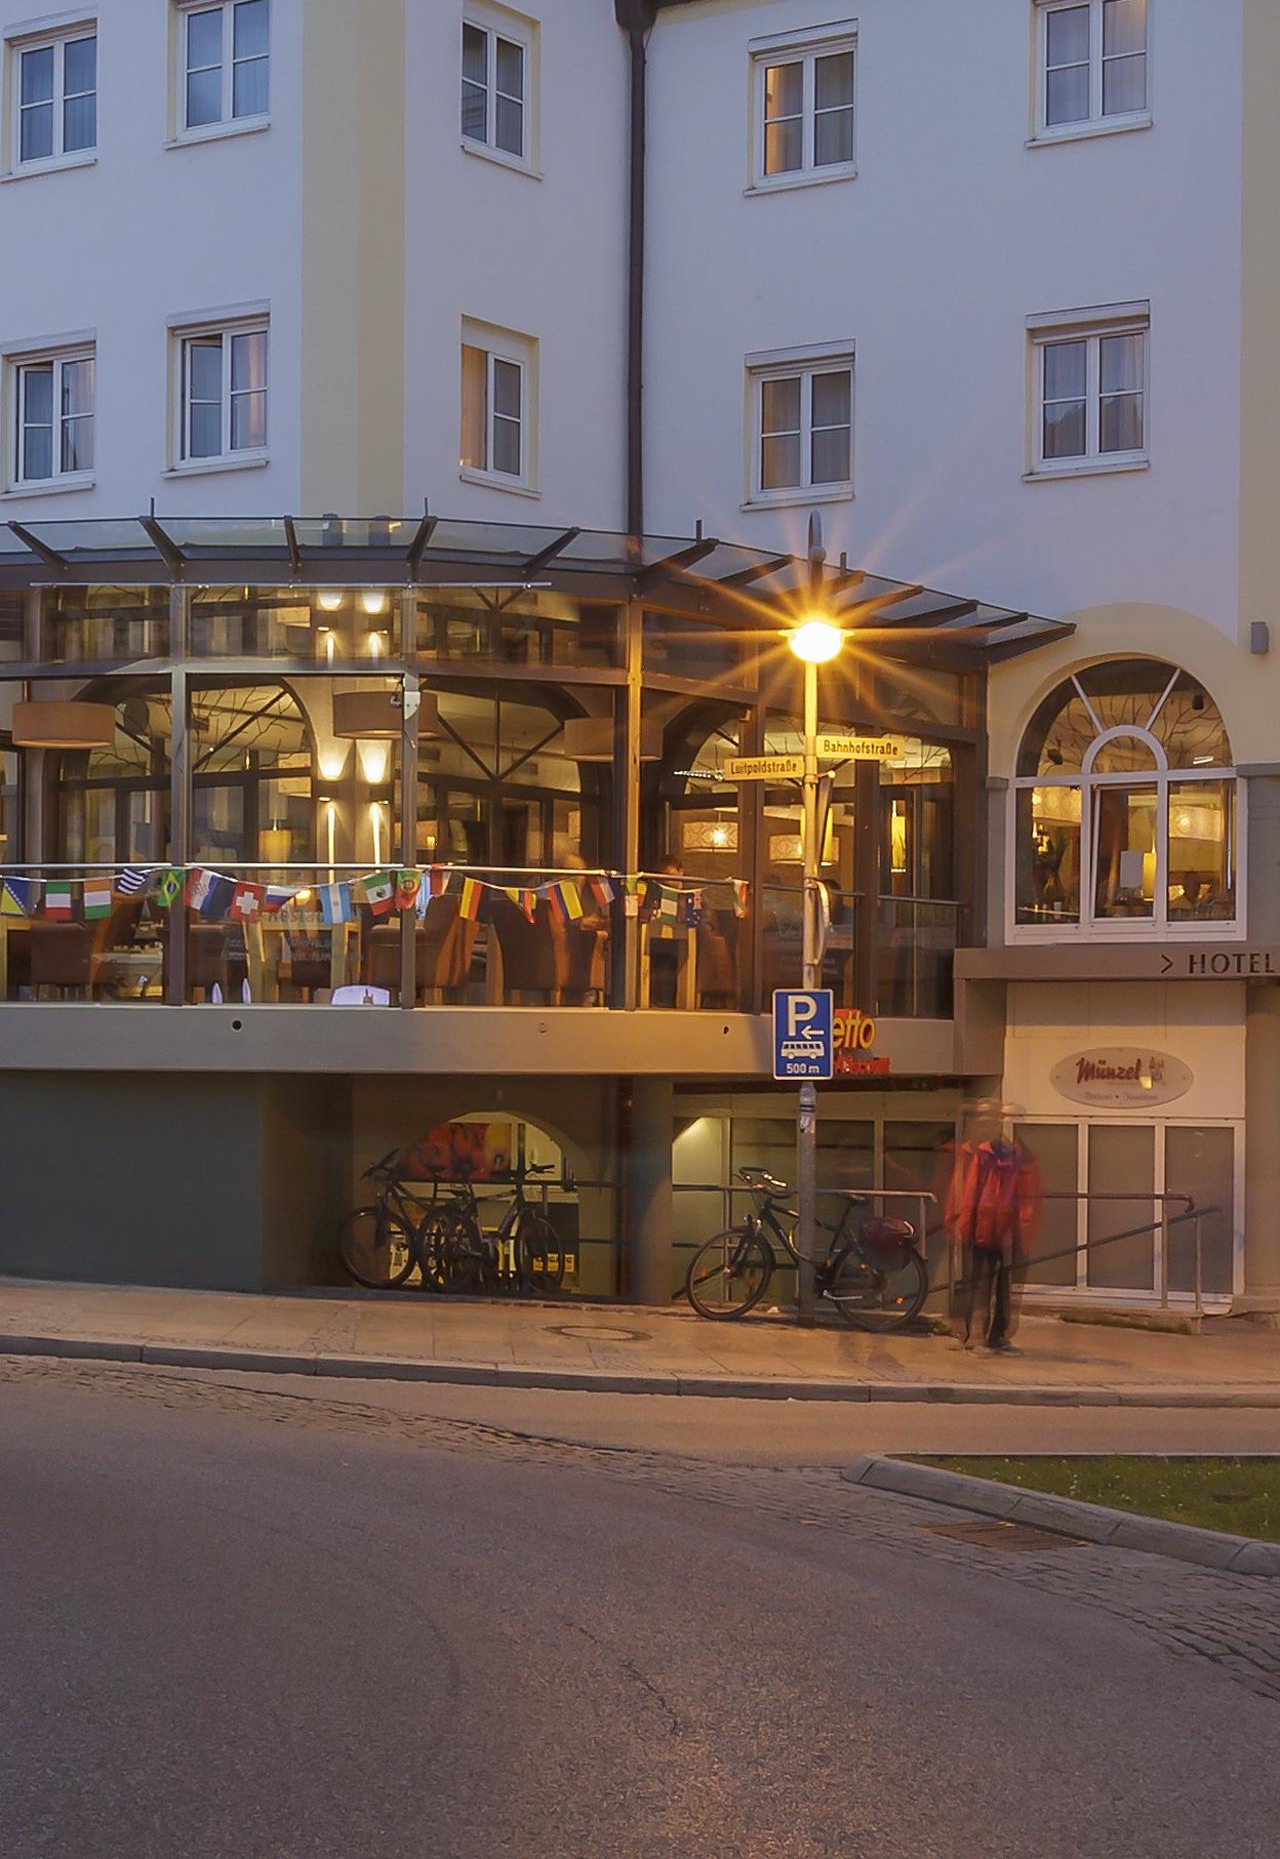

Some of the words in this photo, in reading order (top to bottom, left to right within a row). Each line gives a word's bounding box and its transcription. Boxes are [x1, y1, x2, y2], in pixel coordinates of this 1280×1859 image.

[823, 740, 898, 756] Bahnhofstraße
[730, 759, 797, 775] Luitpoldstraße
[1188, 953, 1275, 974] HOTEL
[788, 995, 817, 1037] P
[833, 1010, 876, 1049] etto
[786, 1063, 807, 1074] 500
[808, 1065, 820, 1074] m
[1075, 1057, 1143, 1085] Münzel
